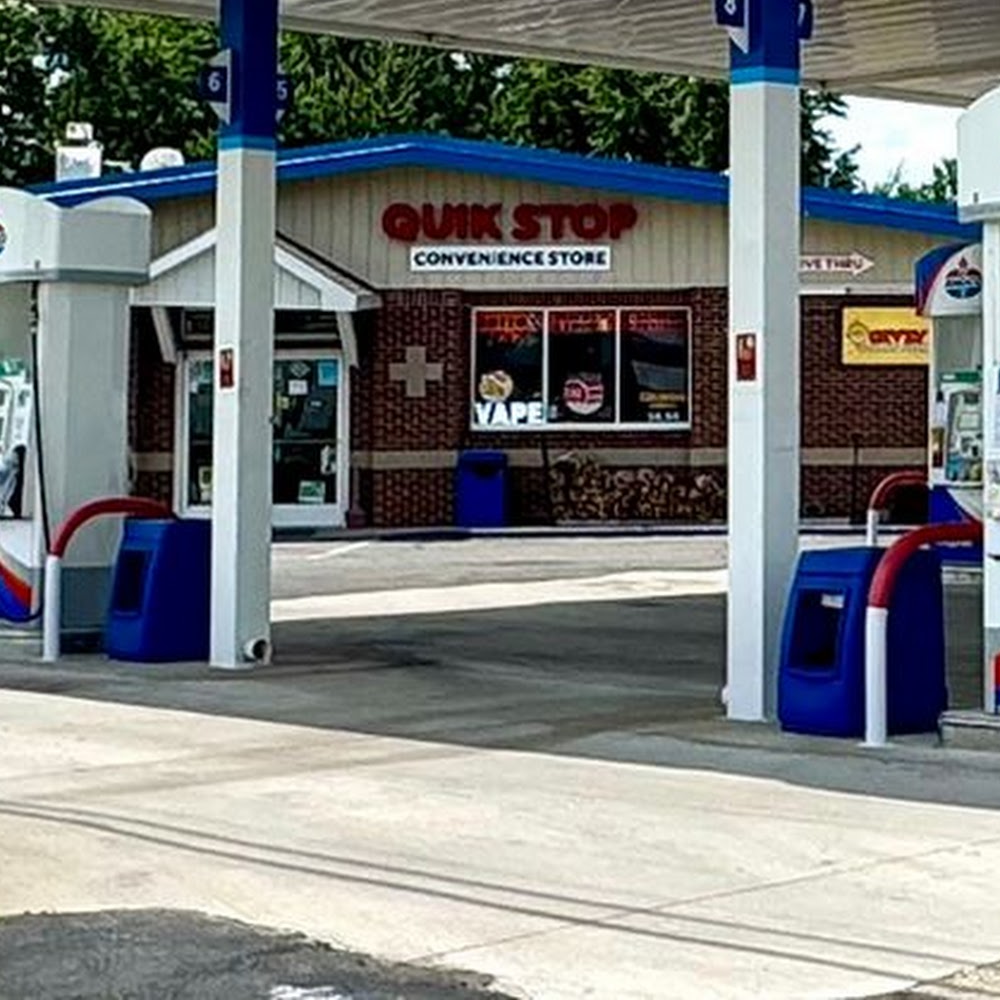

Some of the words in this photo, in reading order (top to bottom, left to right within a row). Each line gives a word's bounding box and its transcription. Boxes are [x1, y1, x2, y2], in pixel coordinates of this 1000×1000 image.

[208, 71, 222, 93] 6
[276, 80, 289, 101] 5
[382, 202, 503, 243] QUIK
[511, 202, 638, 241] STOP
[414, 251, 545, 267] CONVENIENCE
[549, 251, 607, 266] STORE
[476, 401, 544, 426] VAPE
